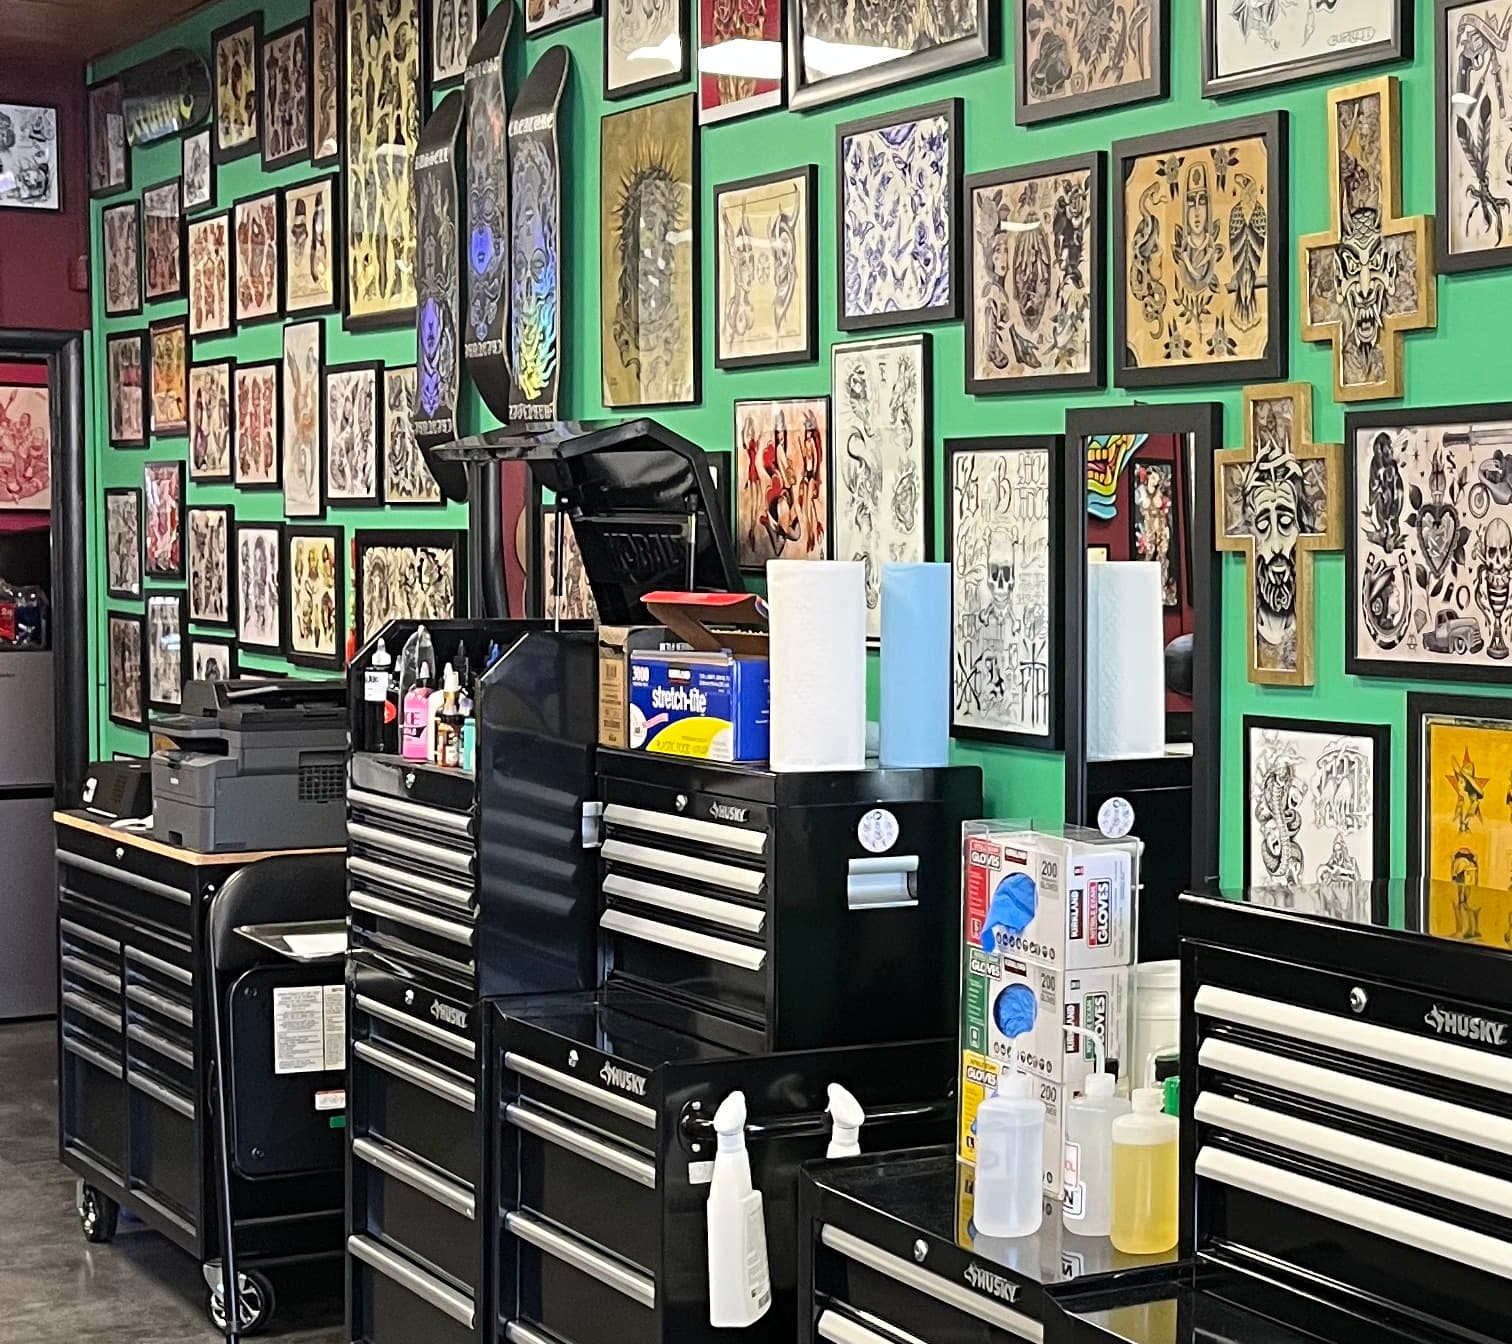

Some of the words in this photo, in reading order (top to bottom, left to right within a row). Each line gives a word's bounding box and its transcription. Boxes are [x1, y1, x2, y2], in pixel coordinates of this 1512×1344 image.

[652, 686, 708, 713] stretch-tite
[719, 805, 749, 822] HUSKY
[1042, 860, 1058, 878] 200
[1097, 883, 1109, 943] GLOVES
[1041, 973, 1056, 991] 200
[440, 1003, 468, 1029] HUSKY
[1445, 1012, 1507, 1045] HUSKY
[612, 1067, 647, 1096] HUSKY
[968, 1067, 997, 1087] GLOVES
[1040, 1083, 1056, 1103] 200
[978, 1267, 1021, 1303] HUSKY
